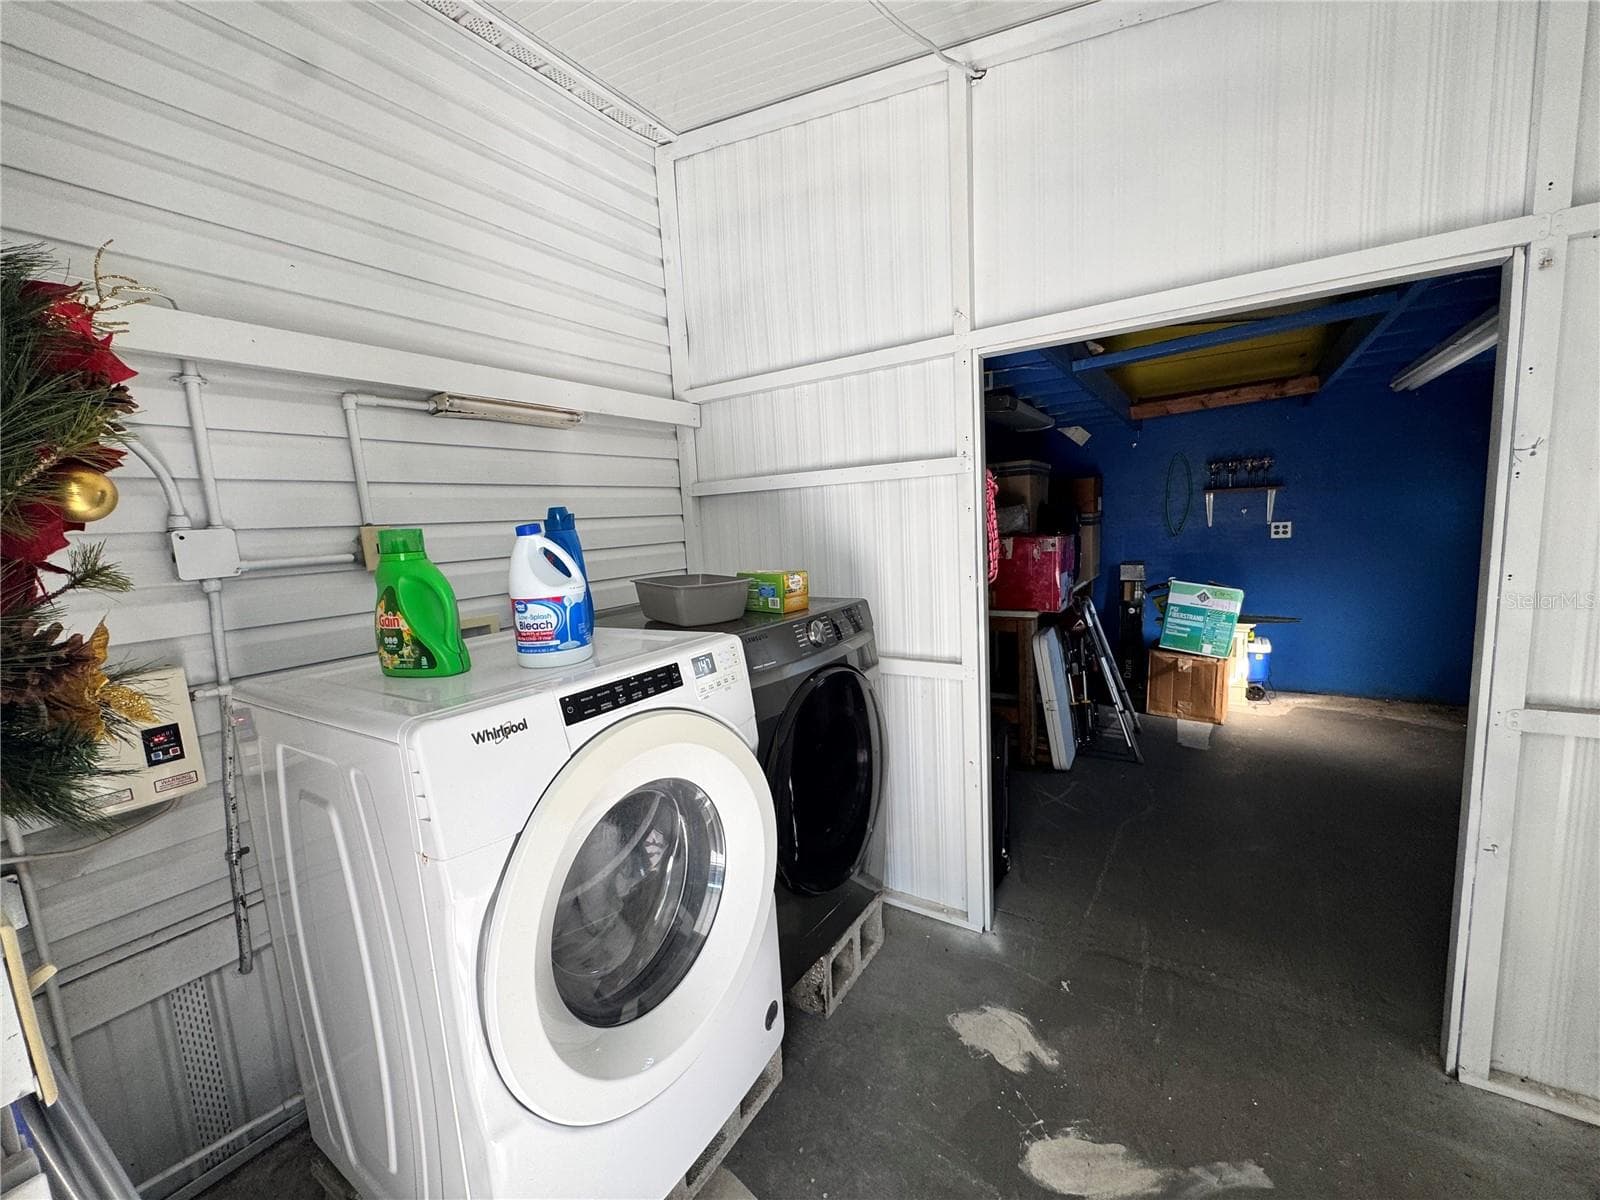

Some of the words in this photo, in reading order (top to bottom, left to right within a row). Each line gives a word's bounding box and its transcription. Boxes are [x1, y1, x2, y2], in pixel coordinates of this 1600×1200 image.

[380, 611, 401, 629] Gain
[519, 620, 553, 630] Bleach
[471, 717, 528, 745] Whirlpool
